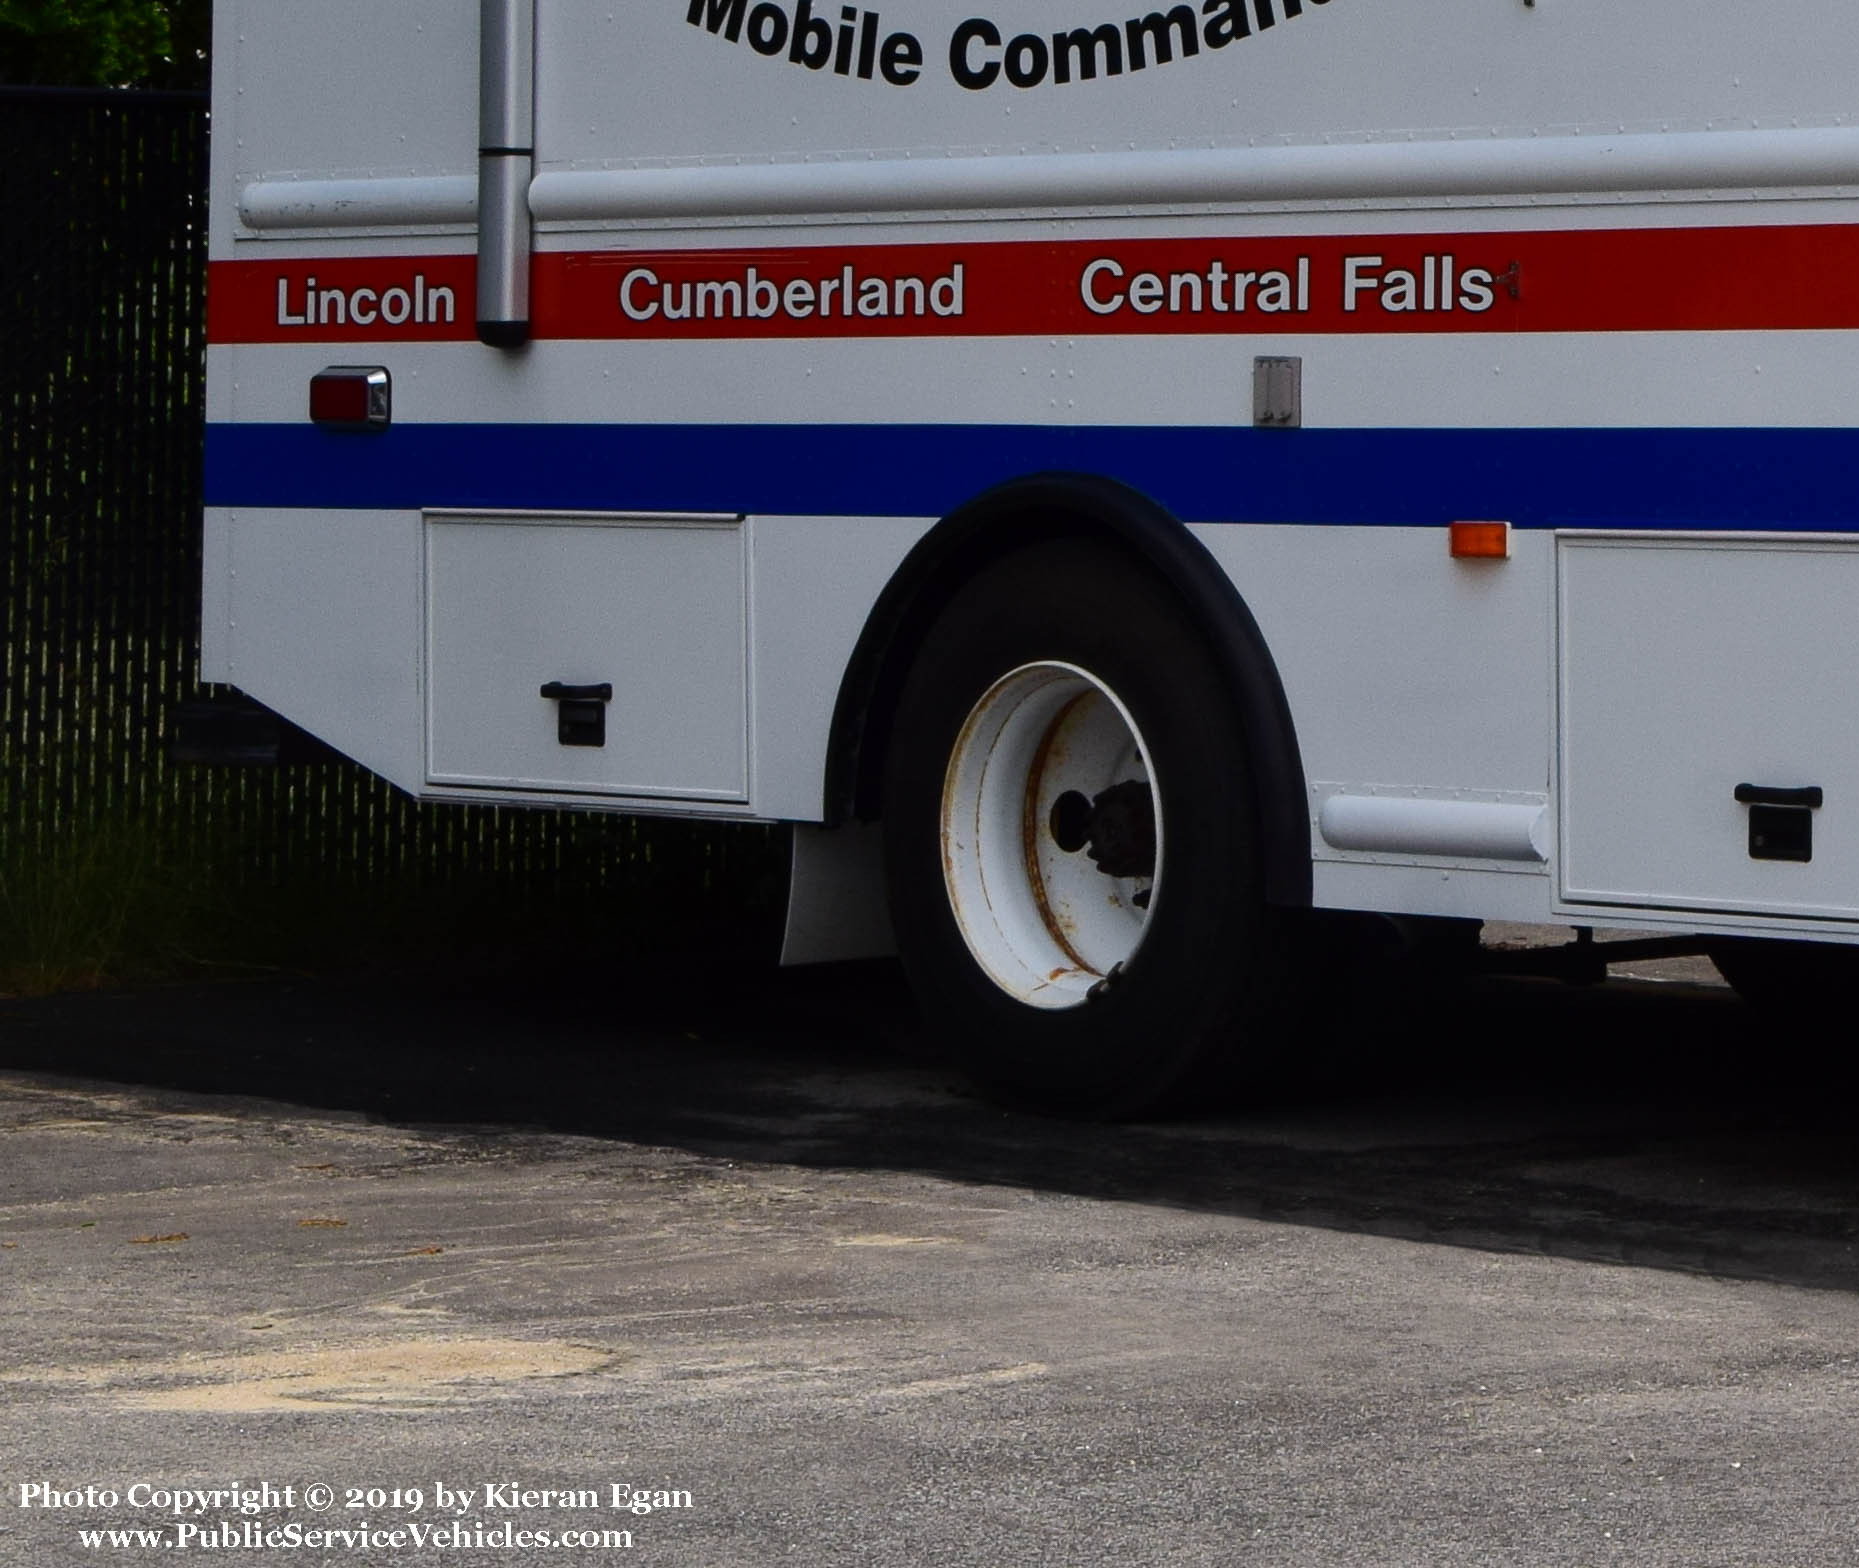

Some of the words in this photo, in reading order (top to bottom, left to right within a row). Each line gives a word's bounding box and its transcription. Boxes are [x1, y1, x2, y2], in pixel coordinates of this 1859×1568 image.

[277, 275, 455, 326] Lincoln
[620, 264, 964, 321] Cumberland
[1080, 257, 1310, 315] Central
[1343, 255, 1495, 312] Falls
